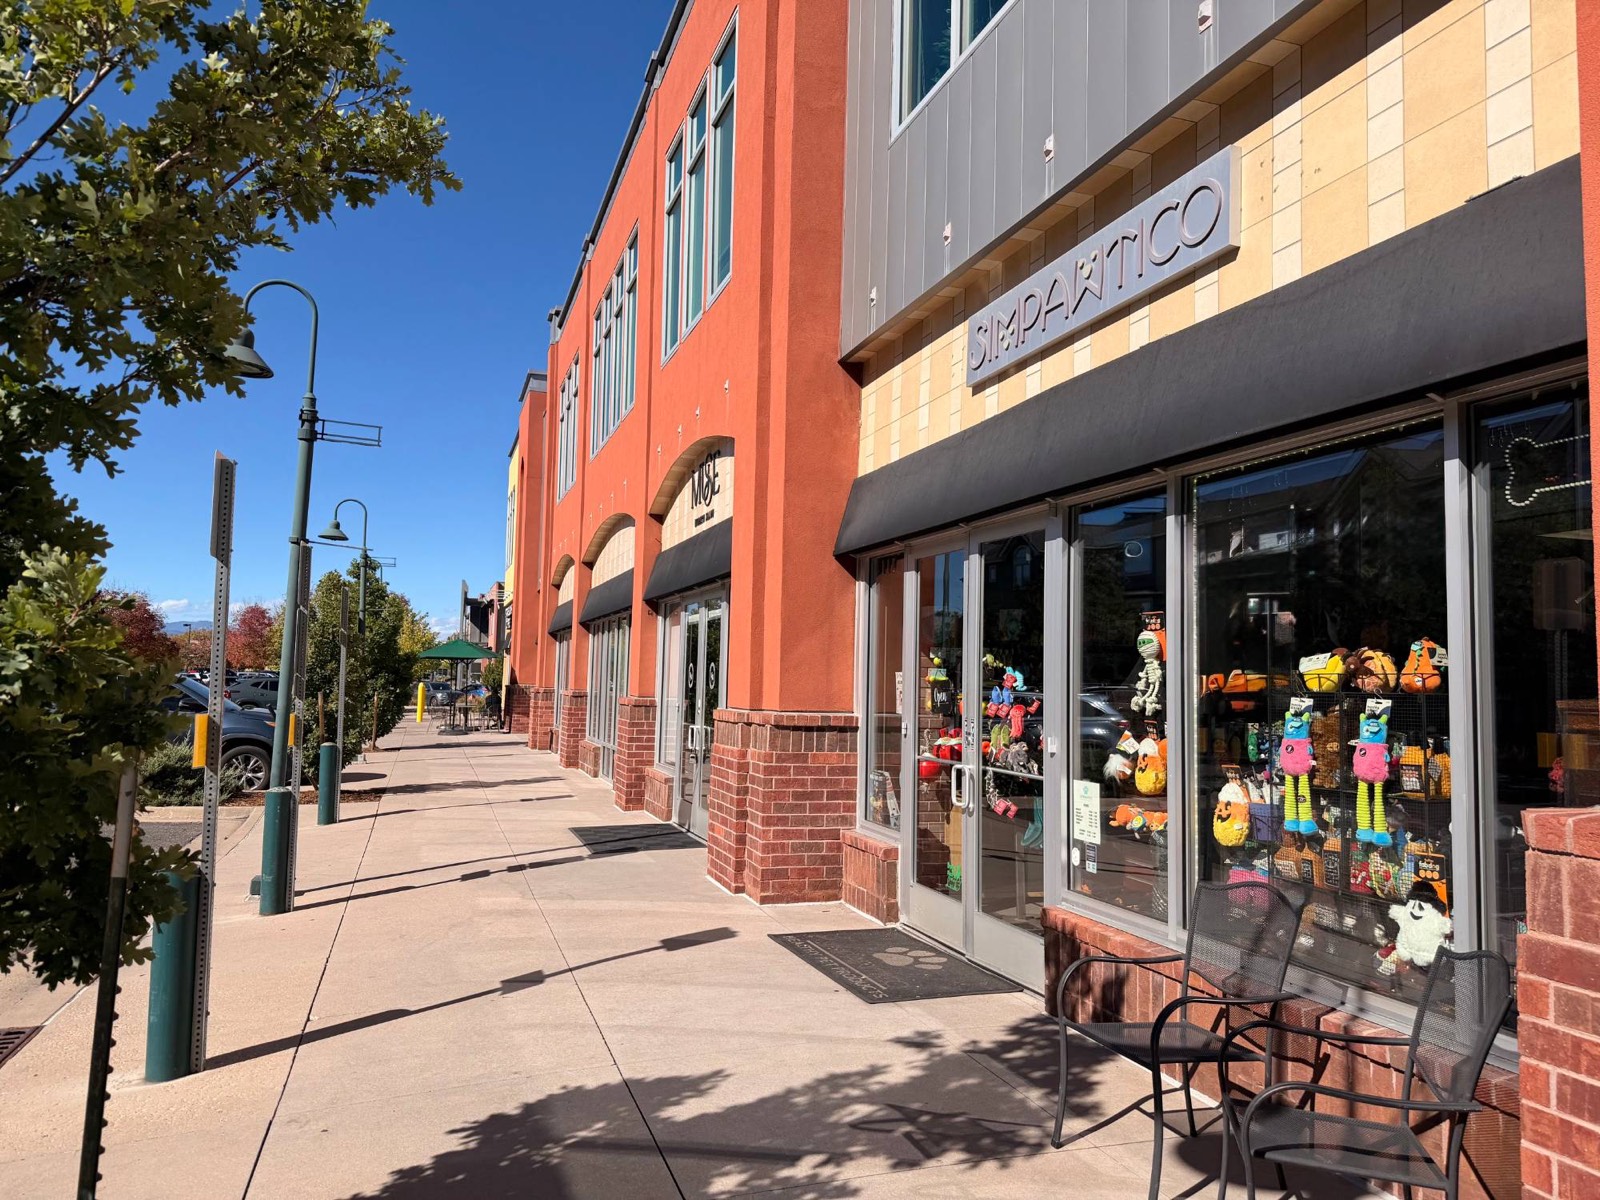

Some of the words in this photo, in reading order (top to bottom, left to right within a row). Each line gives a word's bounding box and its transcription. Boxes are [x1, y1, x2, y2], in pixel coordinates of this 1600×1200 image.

[969, 177, 1224, 371] SIMPAWTICO
[783, 935, 822, 956] HEALTHY
[832, 966, 889, 999] PRODUCTS
